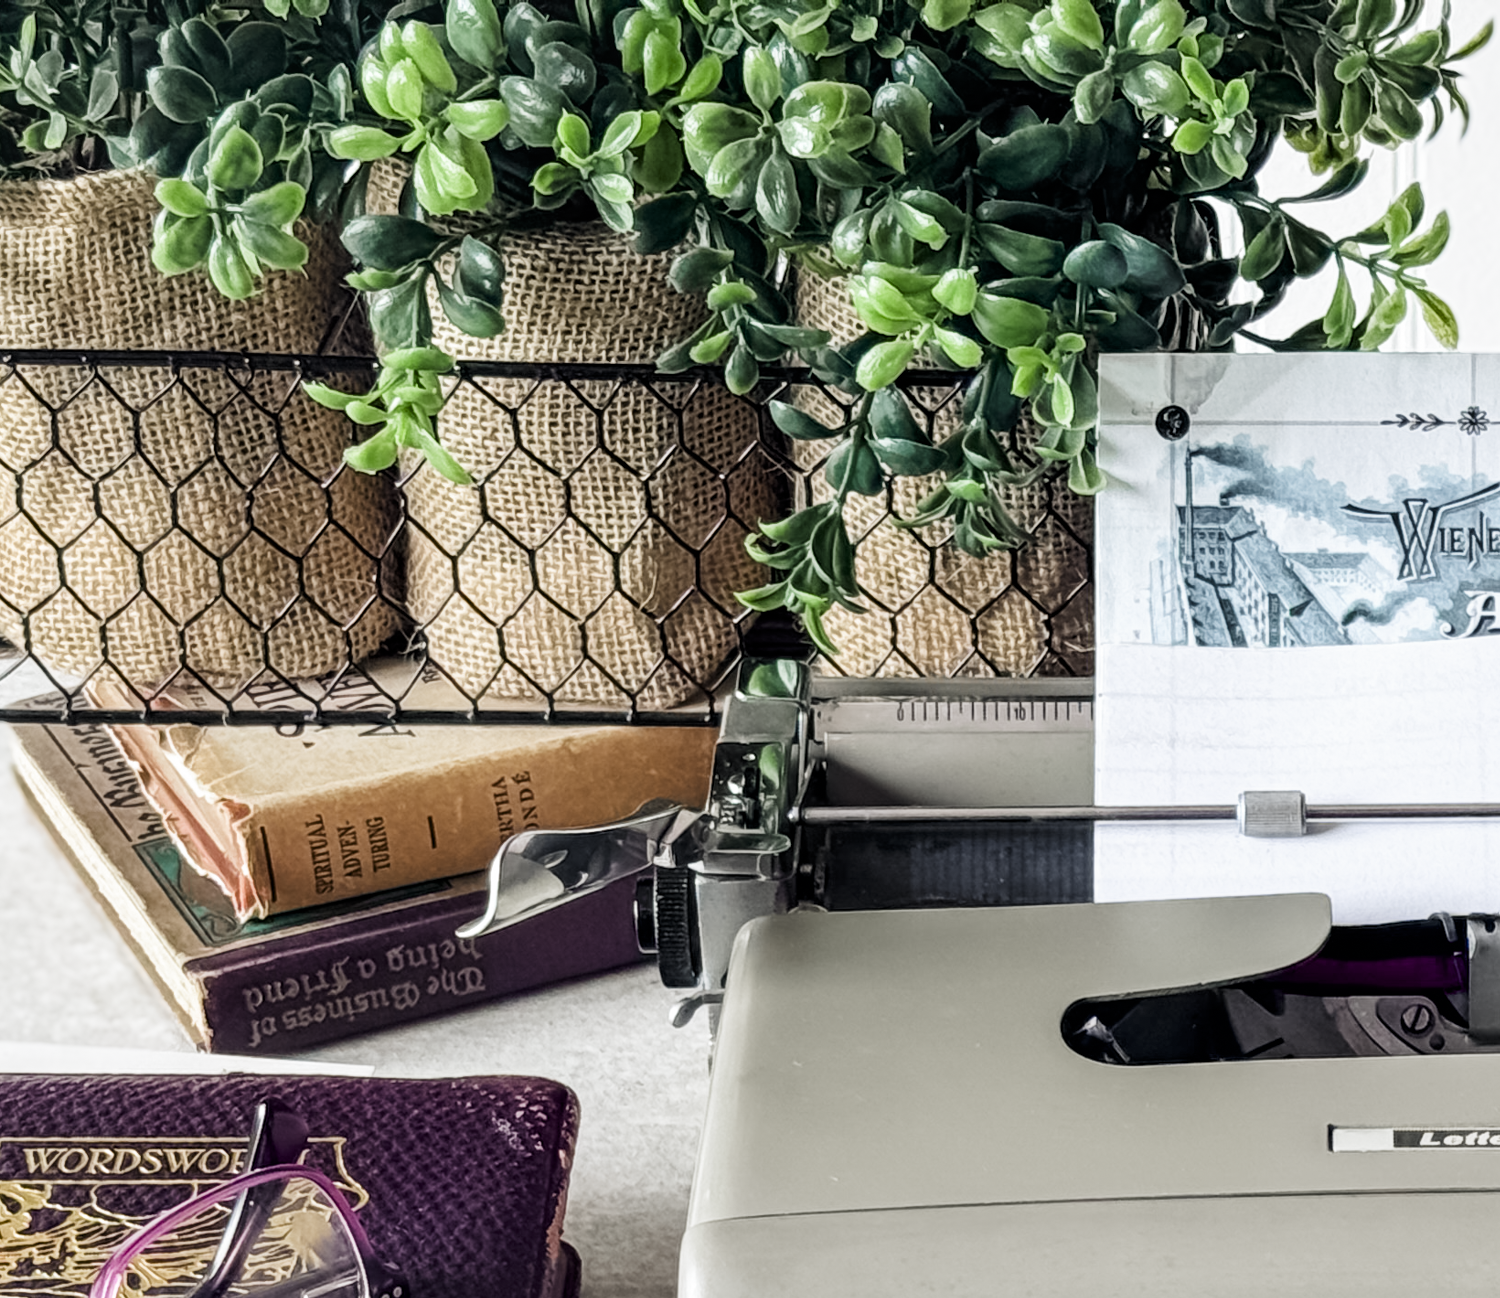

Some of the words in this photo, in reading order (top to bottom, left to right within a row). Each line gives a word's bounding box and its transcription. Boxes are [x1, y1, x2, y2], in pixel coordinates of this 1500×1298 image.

[491, 776, 515, 843] ERTHA
[305, 814, 334, 895] SPIRITUAL
[337, 820, 363, 879] ADVEN-
[366, 816, 391, 873] TURING
[357, 958, 377, 979] a
[427, 966, 486, 996] The
[282, 981, 420, 1030] Business
[249, 1017, 278, 1047] of
[22, 1147, 250, 1176] WORDSWOR
